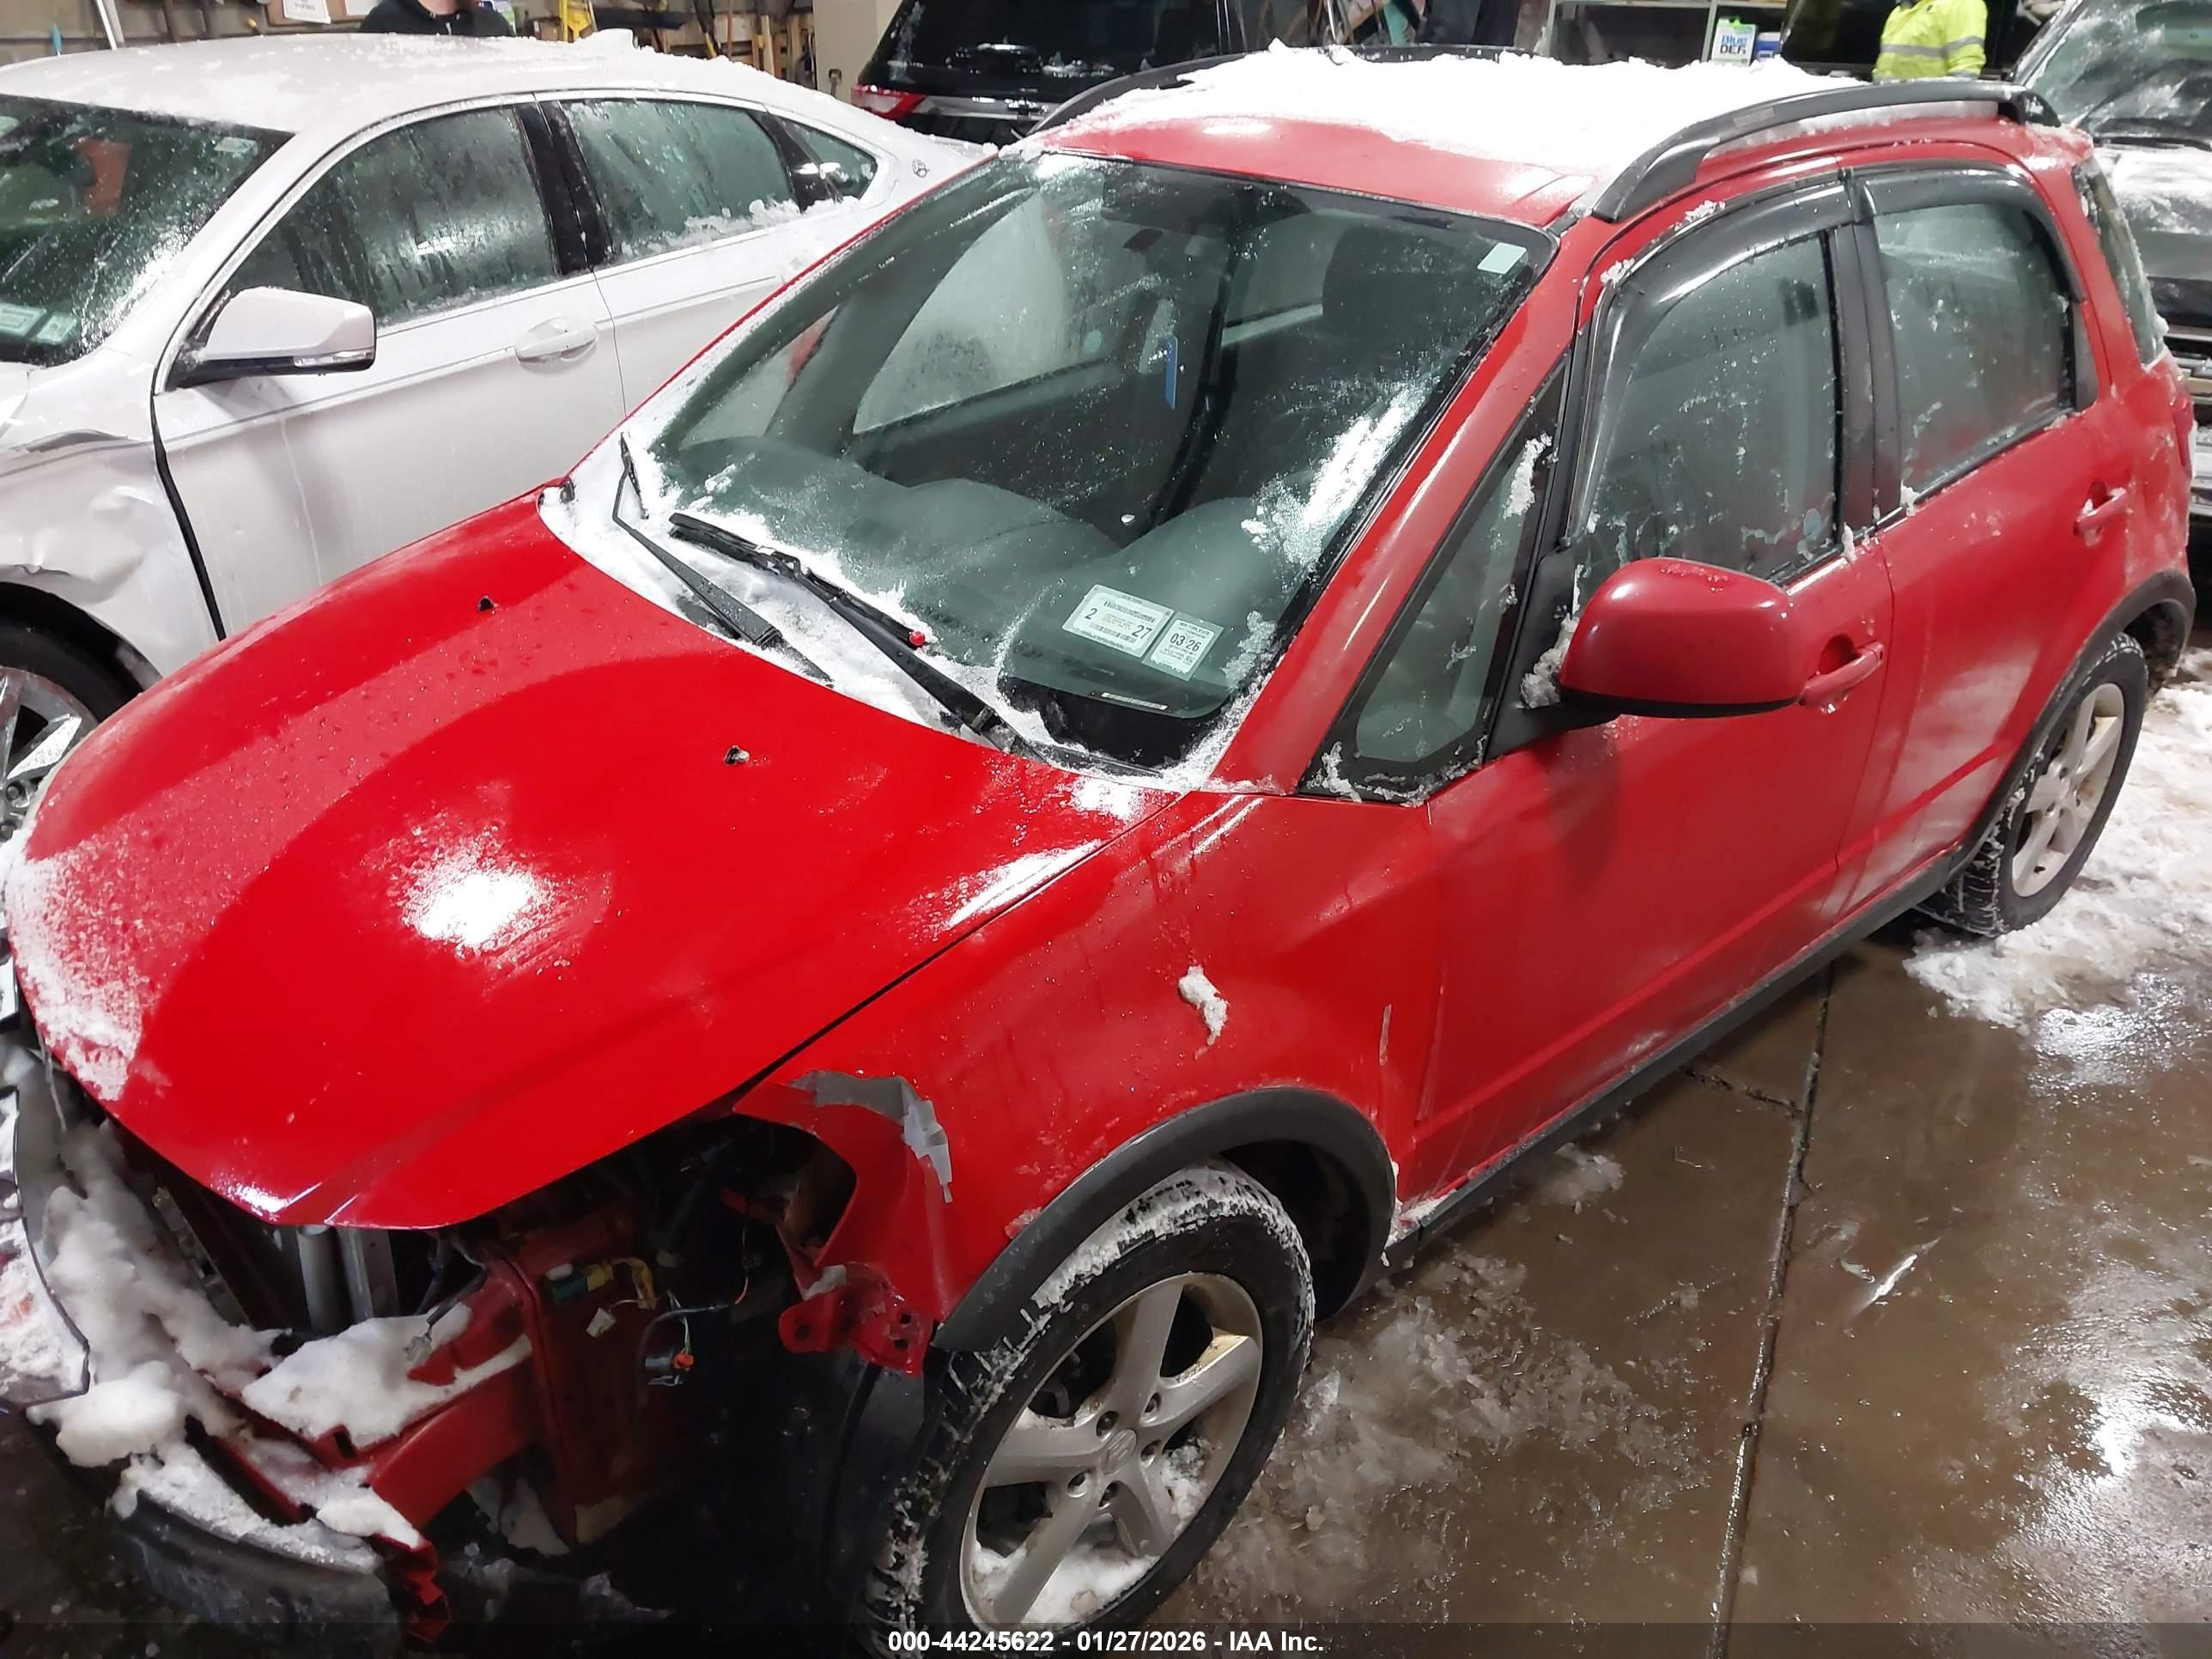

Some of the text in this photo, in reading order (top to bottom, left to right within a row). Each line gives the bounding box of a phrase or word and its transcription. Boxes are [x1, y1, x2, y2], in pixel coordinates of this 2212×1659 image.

[1085, 608, 1097, 620] 2
[1132, 624, 1153, 640] 27
[1170, 633, 1202, 652] 03 26
